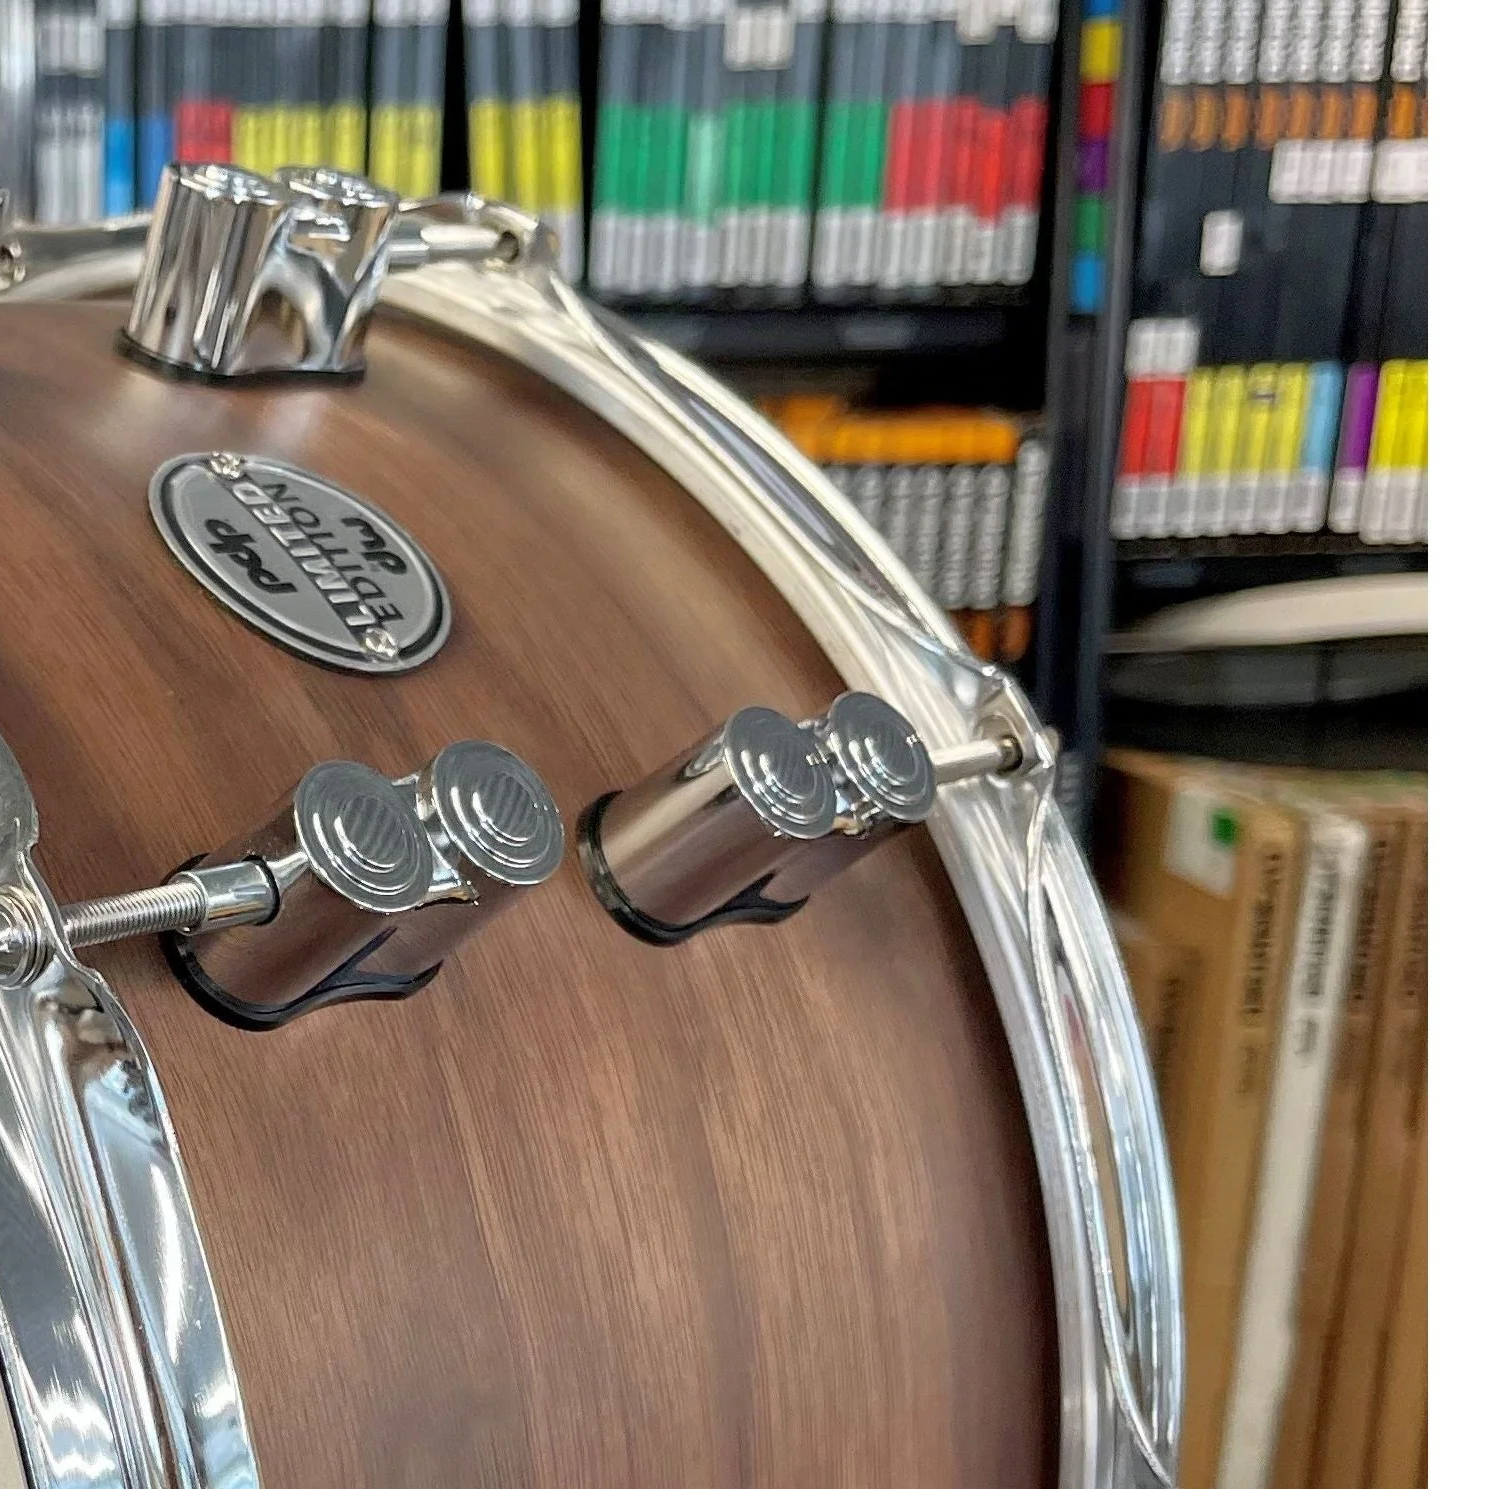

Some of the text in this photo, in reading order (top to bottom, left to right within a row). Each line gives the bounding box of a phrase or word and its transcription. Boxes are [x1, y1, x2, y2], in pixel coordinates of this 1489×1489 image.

[204, 519, 299, 594] pdp
[232, 481, 378, 626] LIMITED
[262, 482, 405, 622] EDITION
[341, 517, 408, 575] dw
